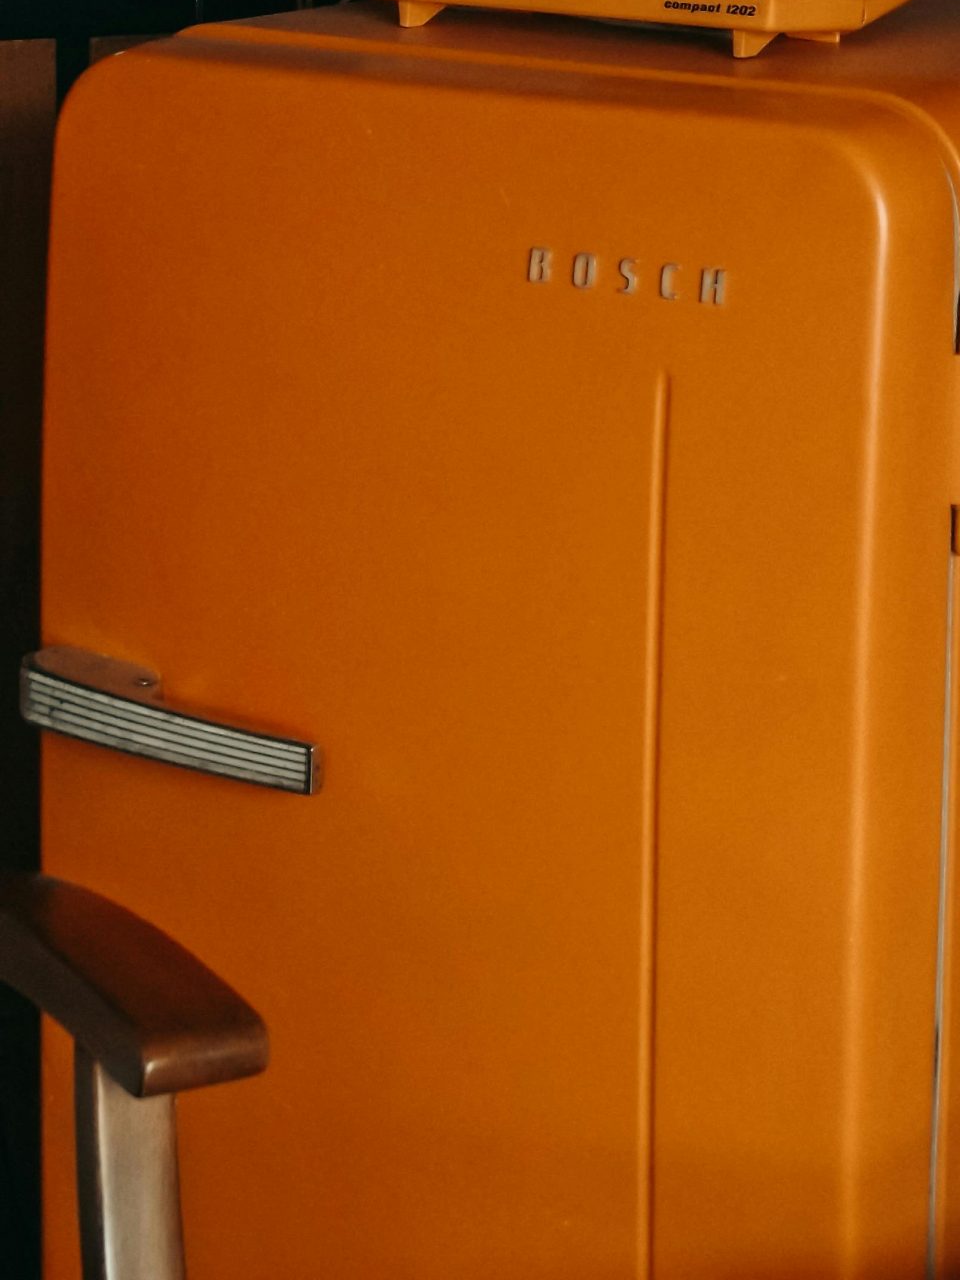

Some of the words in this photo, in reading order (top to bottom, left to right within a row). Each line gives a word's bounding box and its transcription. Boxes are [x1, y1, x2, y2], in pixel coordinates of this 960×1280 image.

[663, 0, 721, 14] compact
[725, 3, 757, 17] 1202
[526, 246, 728, 306] BOSCH
